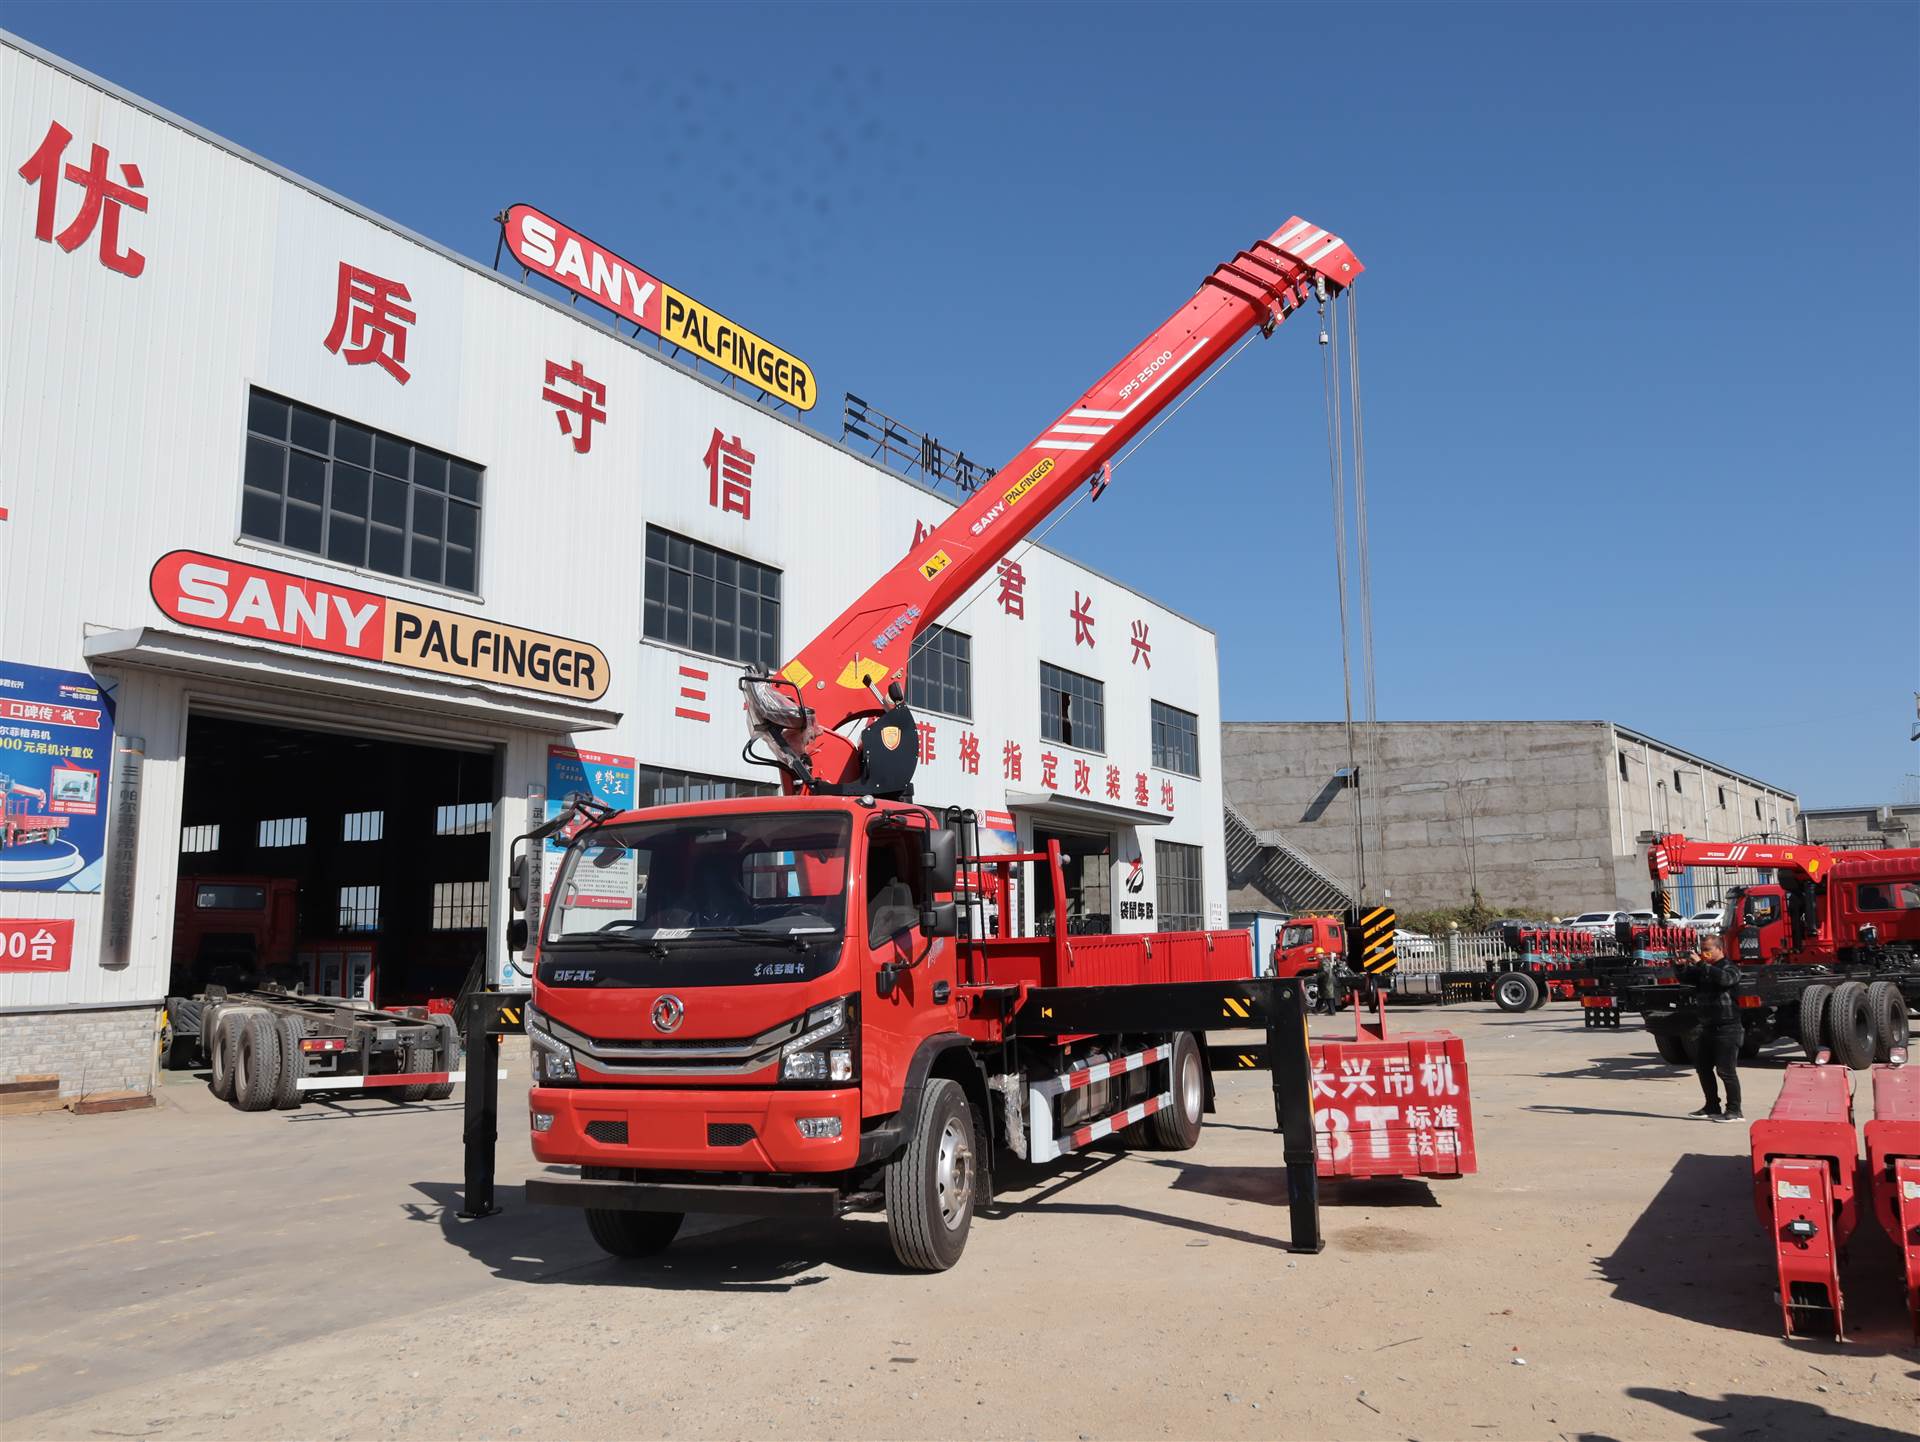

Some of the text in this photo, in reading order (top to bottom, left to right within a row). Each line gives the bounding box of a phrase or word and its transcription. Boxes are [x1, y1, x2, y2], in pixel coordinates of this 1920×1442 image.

[520, 214, 807, 402] SANY PALFINGER
[1119, 350, 1173, 400] SPS 25000
[844, 392, 998, 491] 三一帕尔
[971, 501, 1006, 536] SANY
[1005, 459, 1054, 504] PALFINGER
[177, 563, 595, 691] SANY PALFINGER
[1313, 1054, 1460, 1099] 长兴吊机
[1405, 1104, 1460, 1129] 标准
